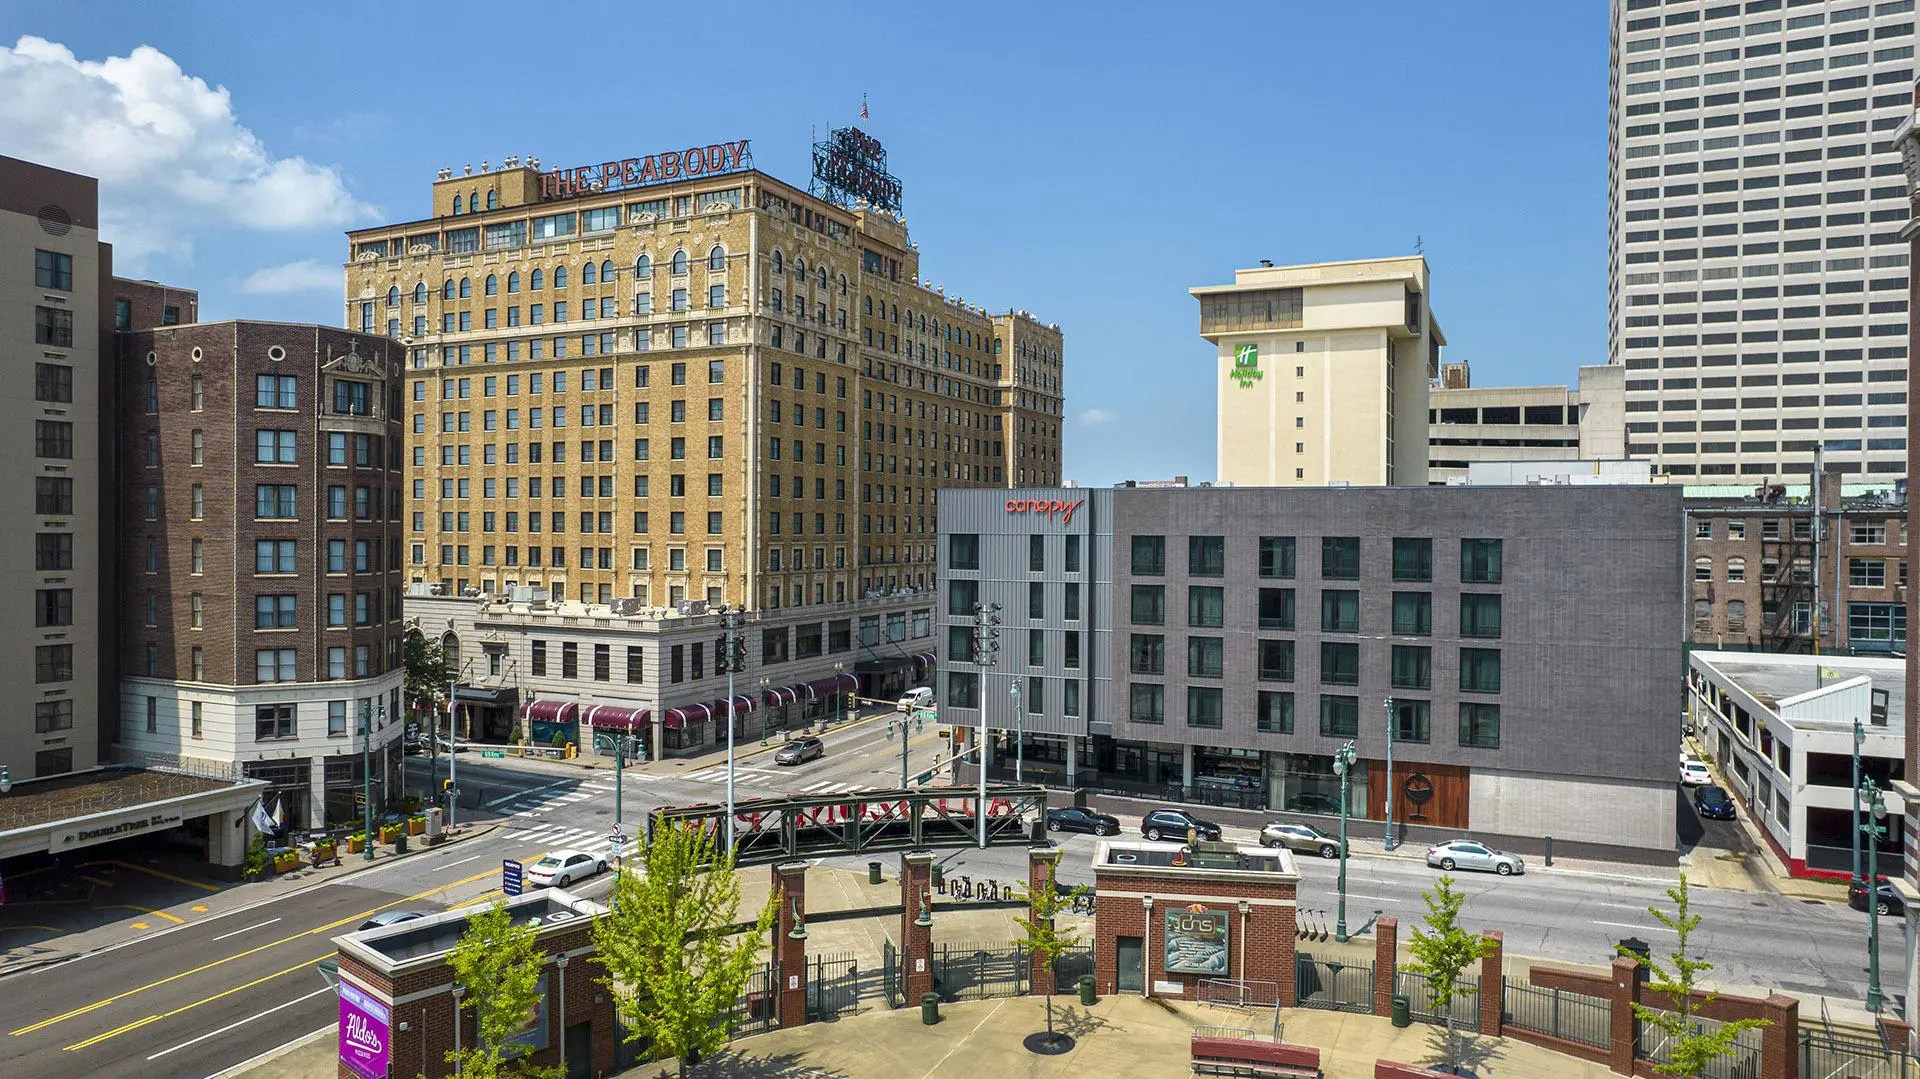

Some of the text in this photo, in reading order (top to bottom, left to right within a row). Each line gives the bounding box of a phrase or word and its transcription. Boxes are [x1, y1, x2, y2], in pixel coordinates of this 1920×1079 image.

[538, 139, 751, 198] THE PEABODY
[1005, 498, 1085, 525] canopy
[346, 1012, 382, 1053] Aldo's
